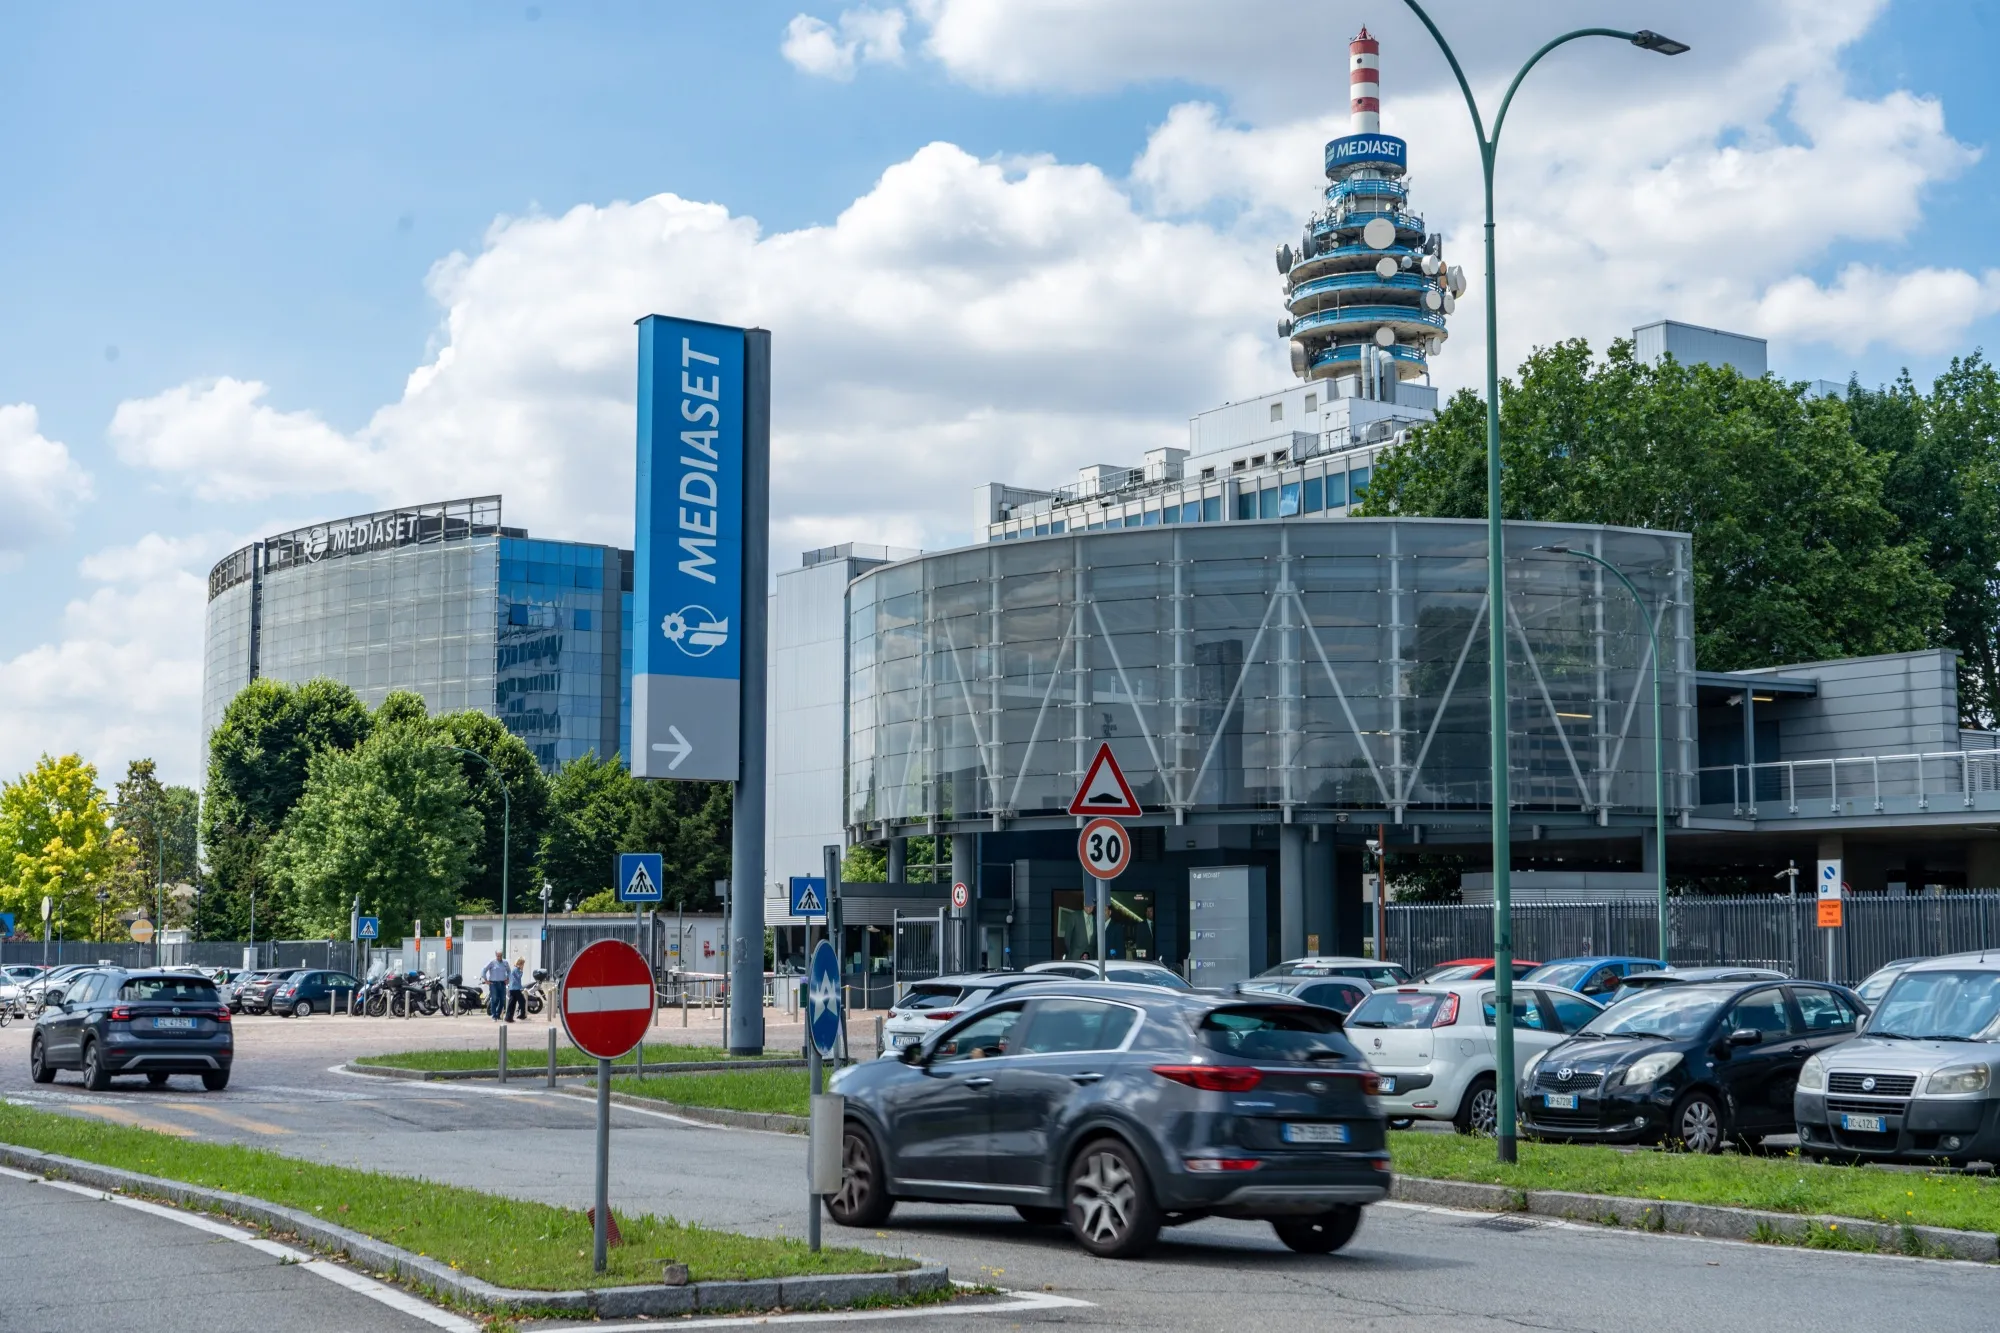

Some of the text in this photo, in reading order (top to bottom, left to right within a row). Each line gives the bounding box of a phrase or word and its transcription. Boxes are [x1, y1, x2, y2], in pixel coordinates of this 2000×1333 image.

[1336, 140, 1402, 159] MEDIASET
[678, 337, 721, 584] MEDIASET
[332, 516, 419, 551] MEDIASET
[1089, 833, 1121, 864] 30
